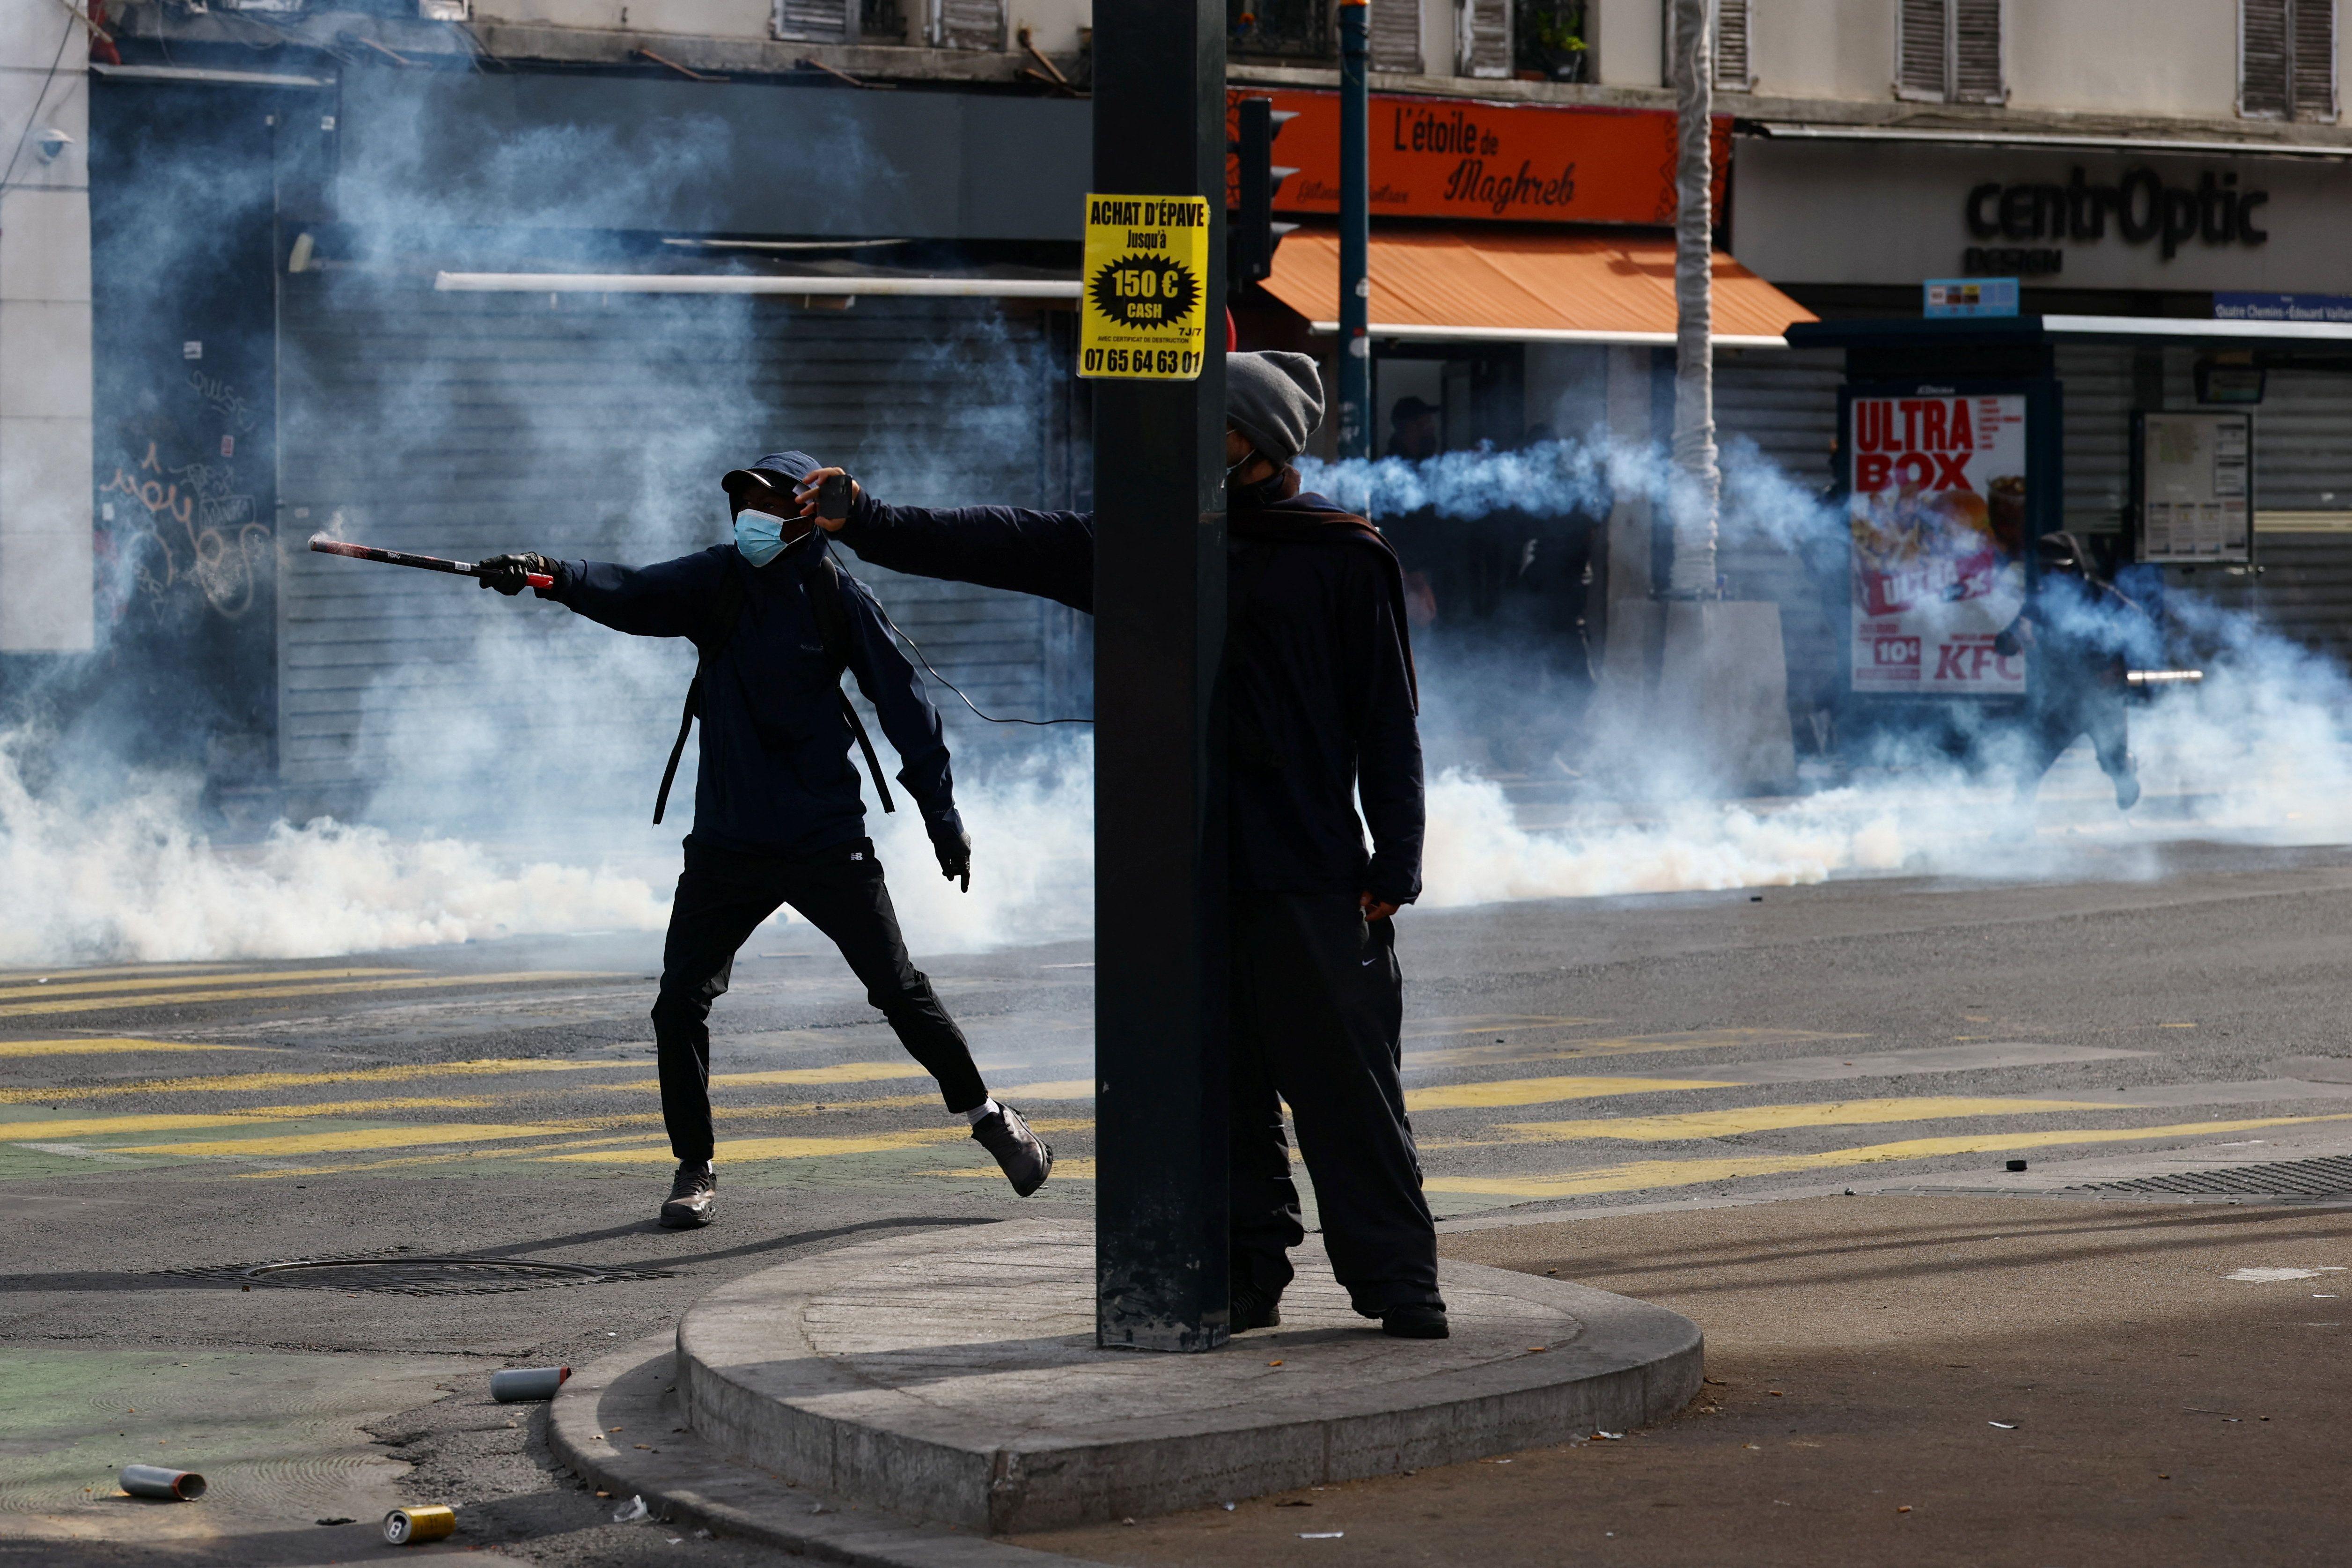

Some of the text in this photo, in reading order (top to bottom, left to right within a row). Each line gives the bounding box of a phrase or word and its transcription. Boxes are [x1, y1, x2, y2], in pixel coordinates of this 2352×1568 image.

[1394, 107, 1497, 155] L'étoile de
[1443, 159, 1576, 215] Maghreb
[1090, 199, 1204, 227] ACHAT D'ÉPAVE
[1127, 230, 1166, 250] Jusqu'à
[1112, 270, 1178, 298] 150 €
[1127, 303, 1162, 319] CASH
[1179, 328, 1201, 336] 7J/7
[1085, 348, 1200, 374] 07 65 64 63 01
[1856, 399, 1974, 451] ULTRA
[1856, 452, 1974, 493] BOX
[1934, 644, 2023, 681] KFC
